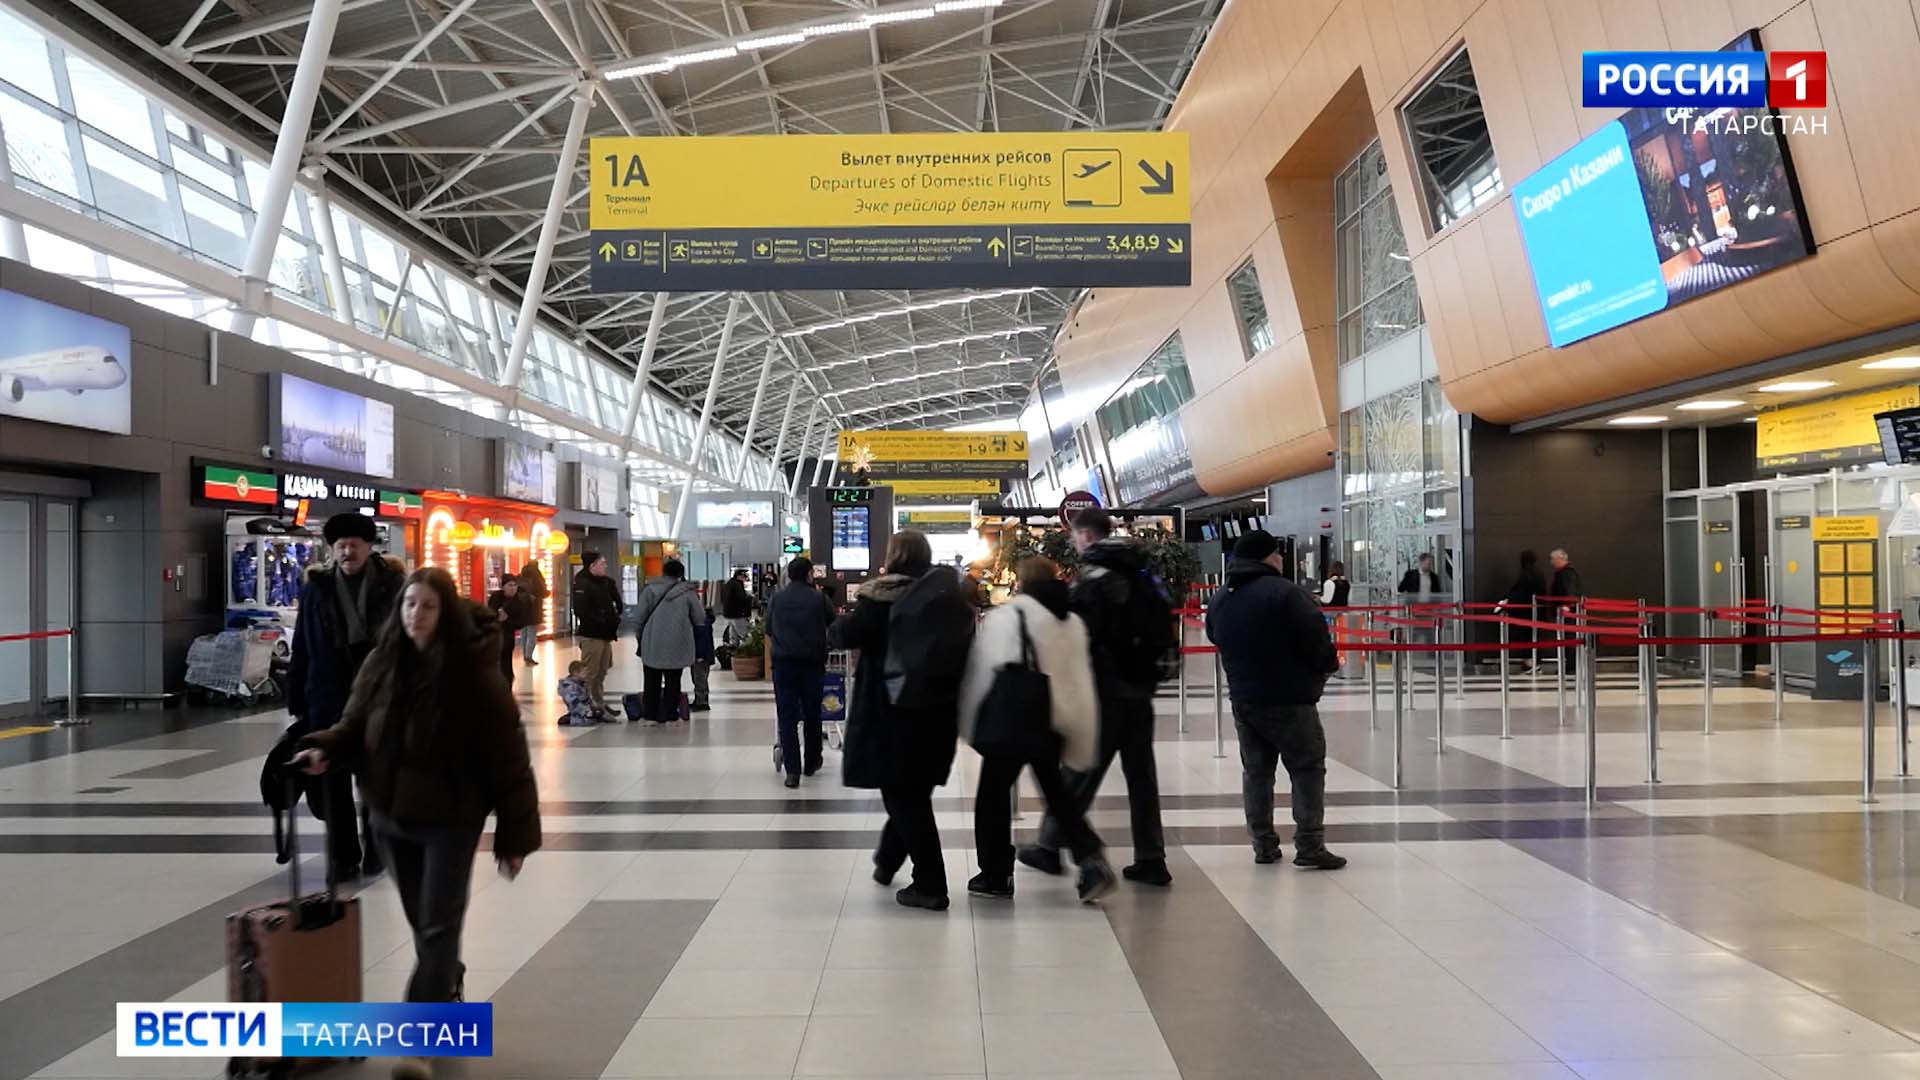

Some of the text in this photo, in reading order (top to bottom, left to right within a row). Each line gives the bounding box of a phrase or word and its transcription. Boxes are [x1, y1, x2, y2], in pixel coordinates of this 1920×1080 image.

[841, 150, 1052, 168] Вылет внутренних рейсов
[604, 154, 650, 188] 1A
[810, 172, 1052, 192] Departures of Domestic Flights
[1522, 184, 1561, 219] Скоро
[1569, 145, 1624, 191] Казани
[607, 206, 649, 216] Terminal
[854, 200, 889, 214] Эчке
[894, 199, 956, 216] рейслар
[961, 197, 1005, 212] белән
[1106, 234, 1160, 252] 3,4,8,9
[284, 473, 328, 500] КАЗАНЬ
